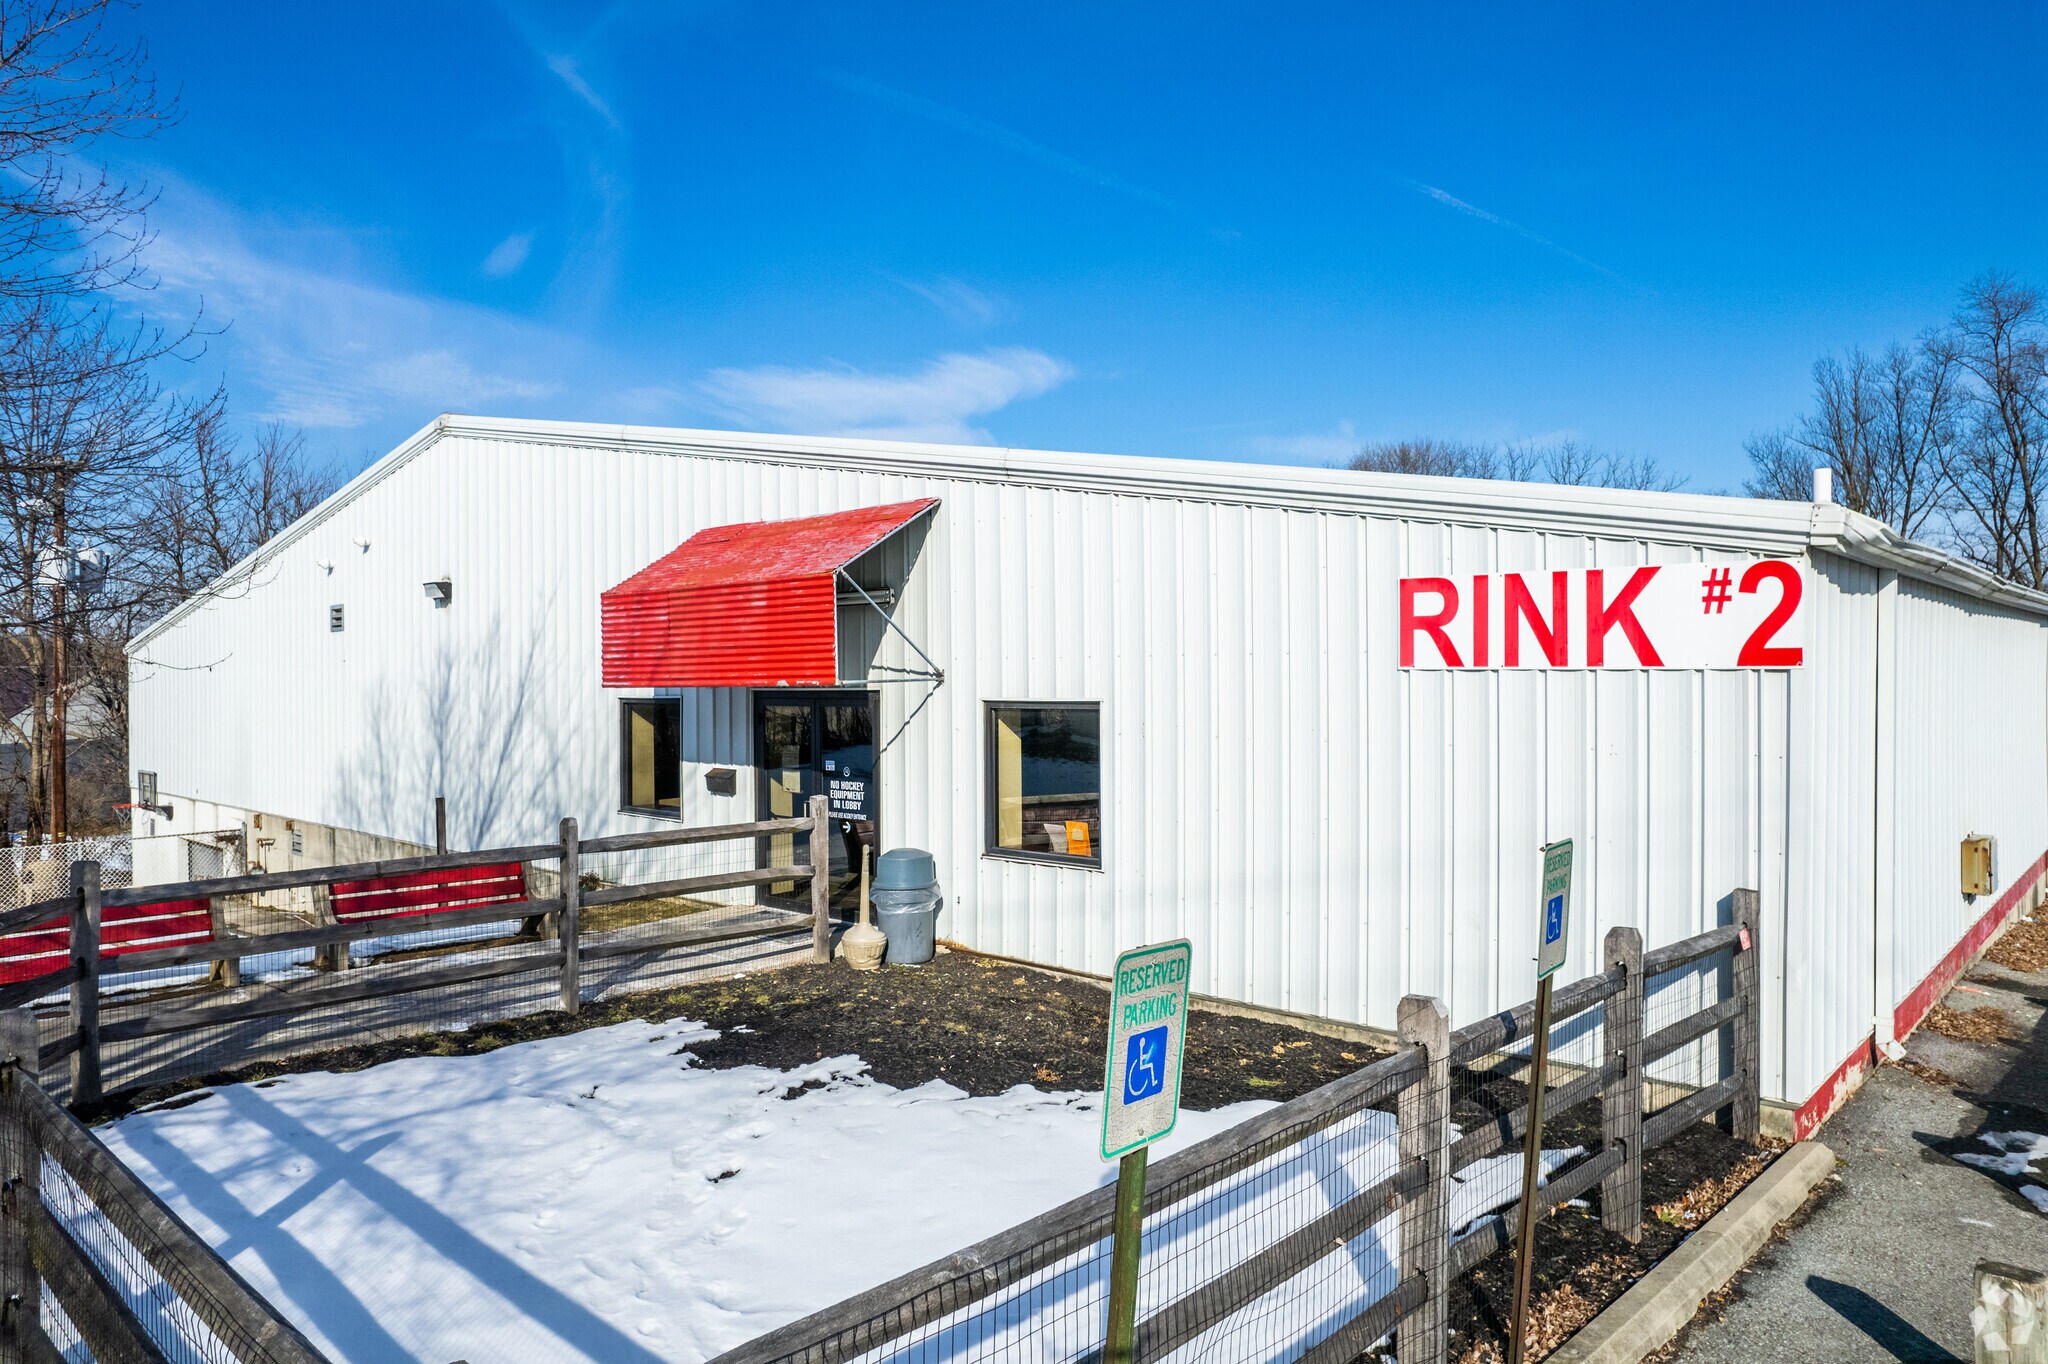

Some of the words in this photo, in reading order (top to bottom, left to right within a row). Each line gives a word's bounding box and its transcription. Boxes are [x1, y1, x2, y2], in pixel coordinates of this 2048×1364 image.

[1400, 566, 1665, 667] RINK
[1702, 560, 1803, 667] #2
[830, 781, 840, 789] NO
[840, 781, 864, 791] HOCKEY
[830, 790, 865, 800] EQUIPMENT
[833, 800, 840, 808] IN
[842, 801, 862, 810] LOBBY
[1546, 851, 1571, 873] RESERVED
[1546, 873, 1568, 894] PARKING
[1120, 958, 1185, 996] RESERVED
[1123, 993, 1177, 1029] PARKING
